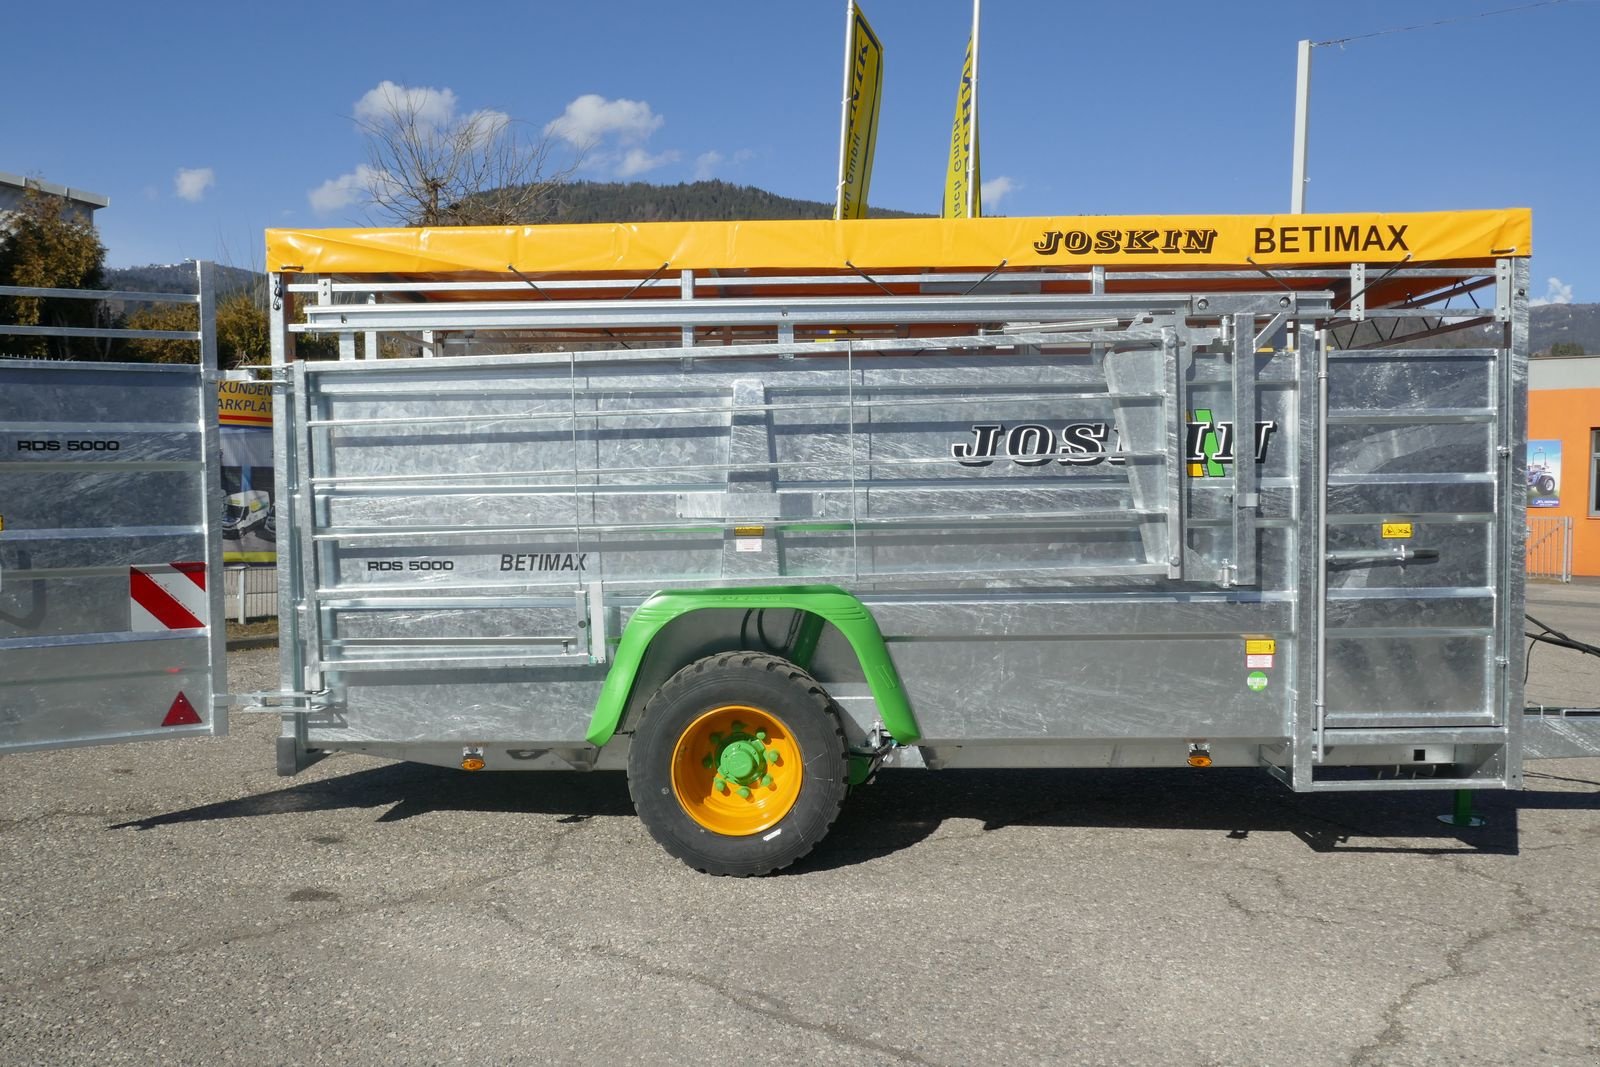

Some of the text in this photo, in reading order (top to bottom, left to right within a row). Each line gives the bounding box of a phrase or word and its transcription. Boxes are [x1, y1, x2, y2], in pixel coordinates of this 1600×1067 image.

[846, 132, 861, 185] GmbH
[1033, 225, 1409, 255] JOSKIN BETIMAX
[218, 381, 272, 396] KUNDEN
[217, 397, 272, 412] ARKPLÄT
[17, 440, 120, 451] RDS 5000
[952, 421, 1278, 468] JOSIN
[367, 553, 588, 572] RDS 5000 BETIMAX
